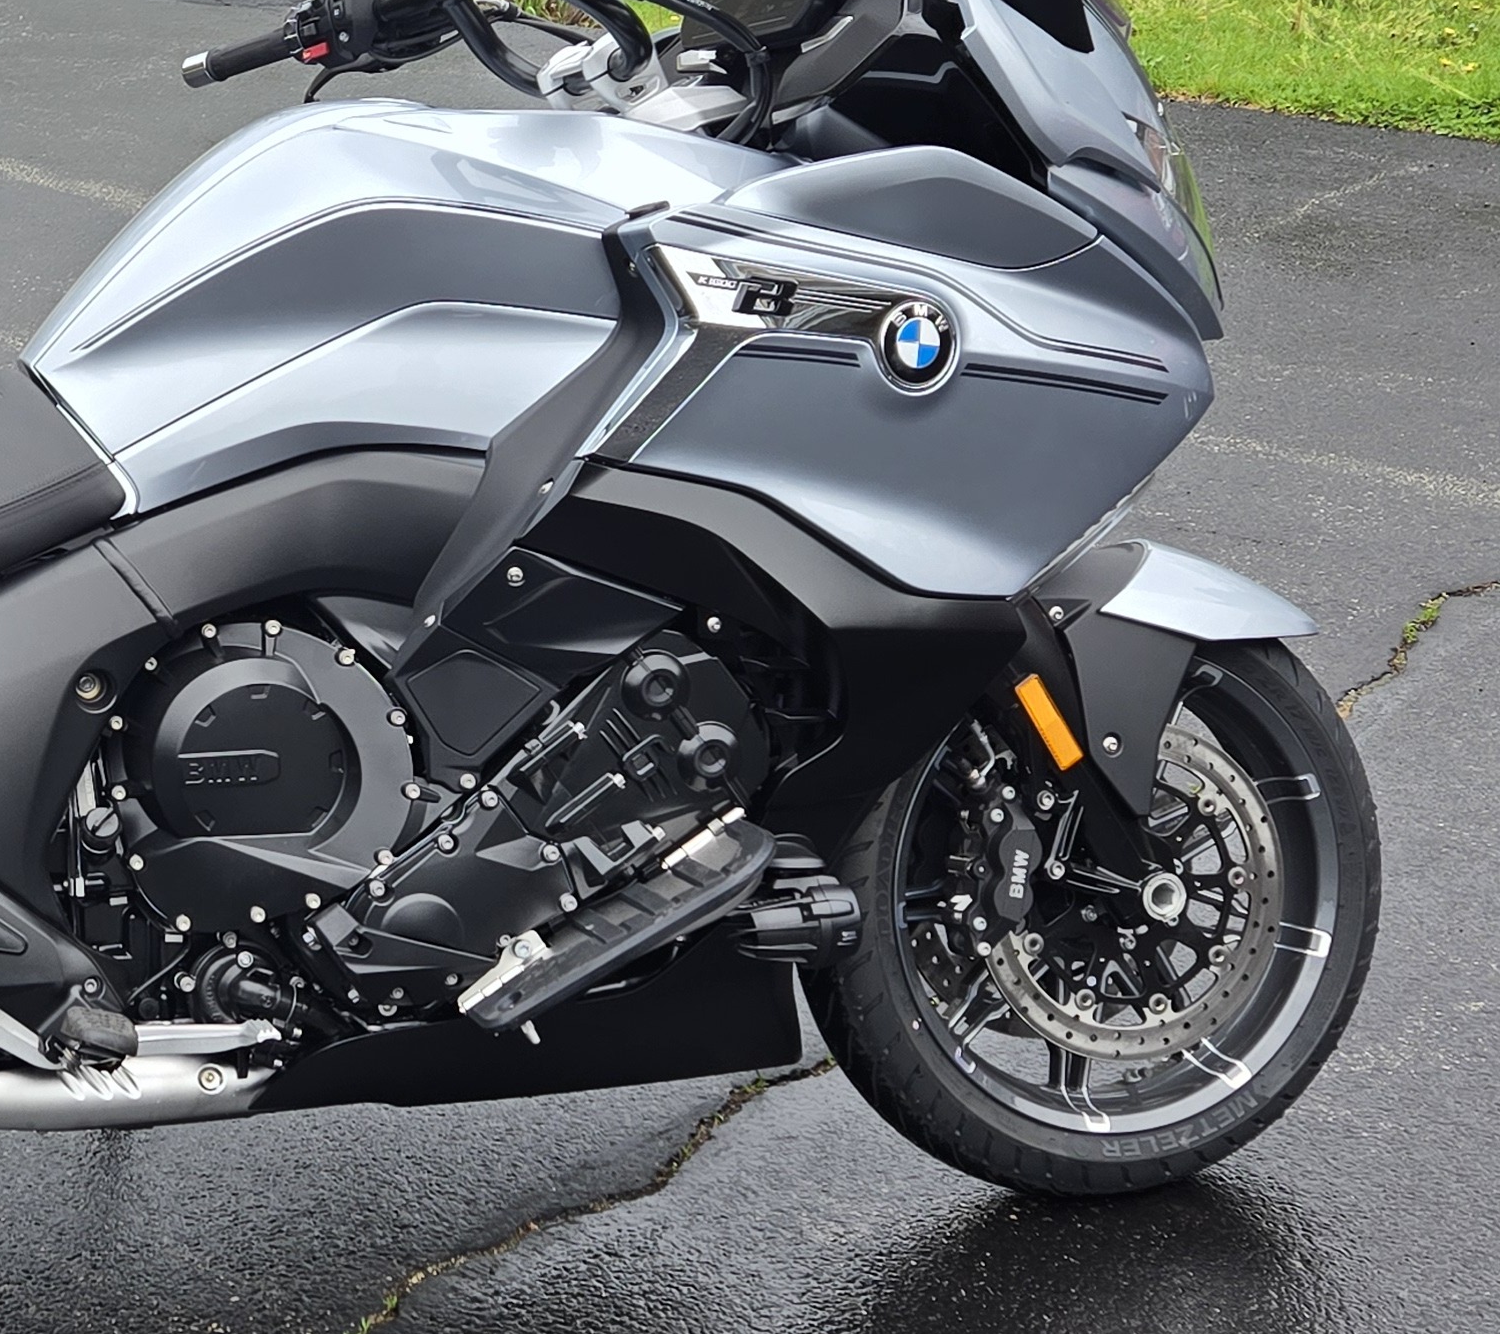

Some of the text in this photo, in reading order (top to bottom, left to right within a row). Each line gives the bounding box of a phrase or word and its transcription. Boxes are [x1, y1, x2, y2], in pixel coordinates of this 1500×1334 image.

[891, 302, 949, 333] BMW
[184, 761, 259, 785] BMW
[1009, 849, 1030, 899] BMW
[1100, 1095, 1260, 1158] METZELER
